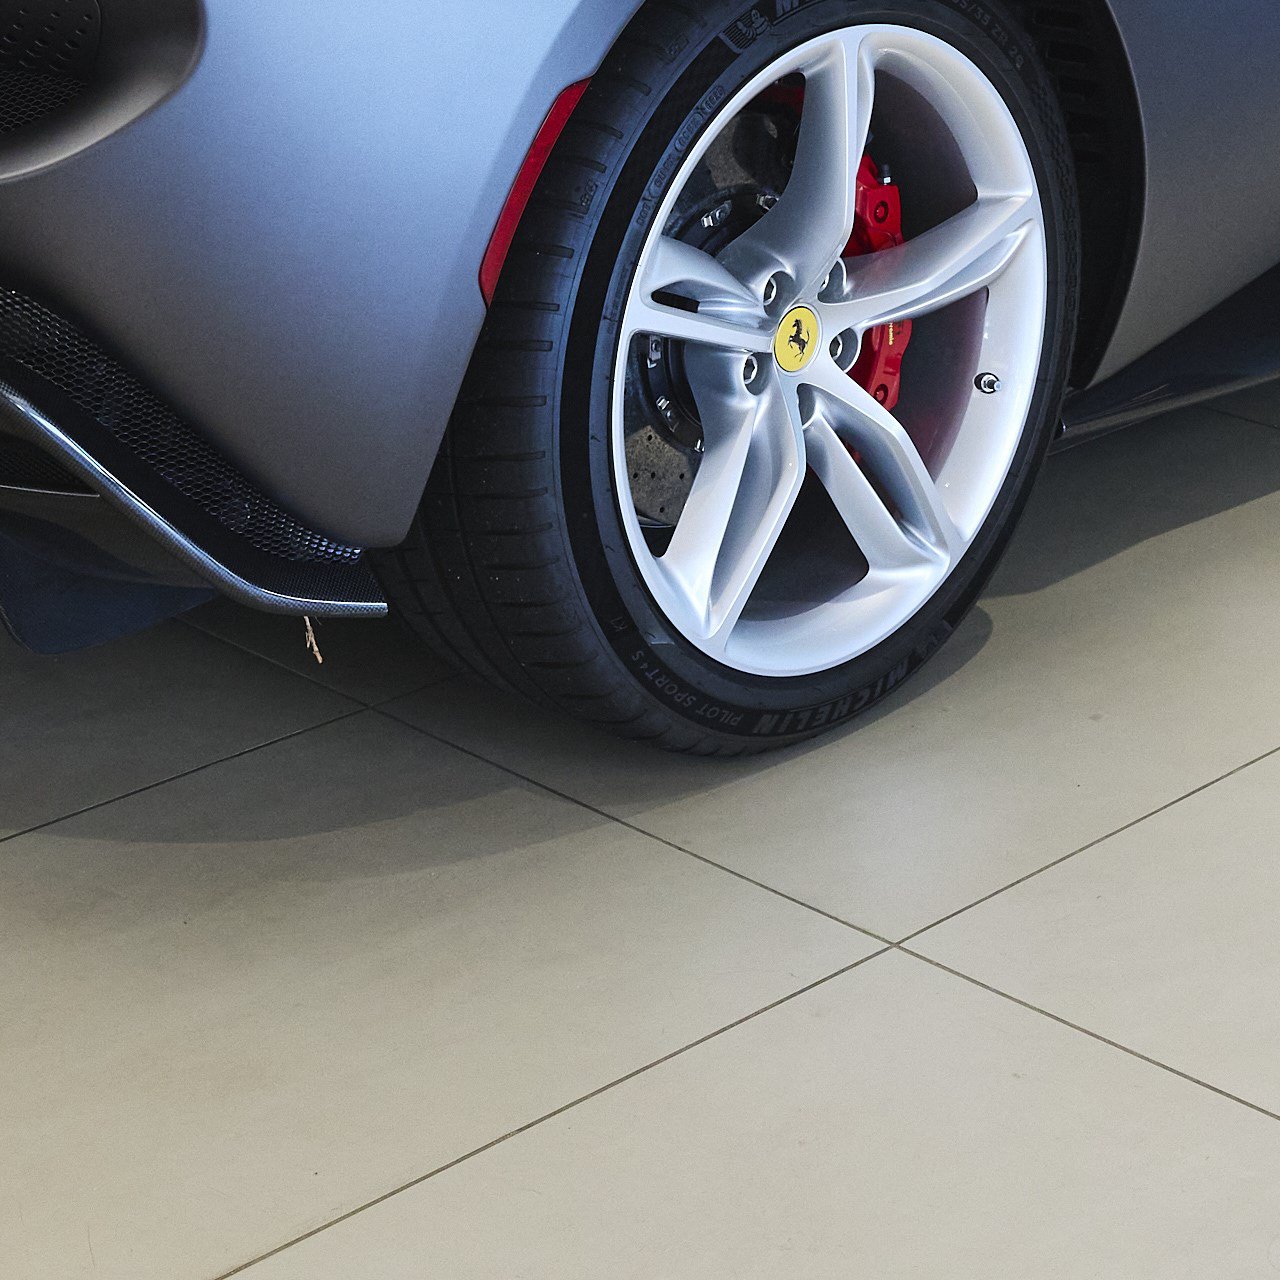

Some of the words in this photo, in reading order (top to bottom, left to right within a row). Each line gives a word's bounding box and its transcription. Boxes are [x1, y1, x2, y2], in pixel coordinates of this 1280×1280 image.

[645, 668, 697, 707] SPORT
[754, 660, 909, 734] MICHELIN
[696, 703, 744, 726] PILOT
